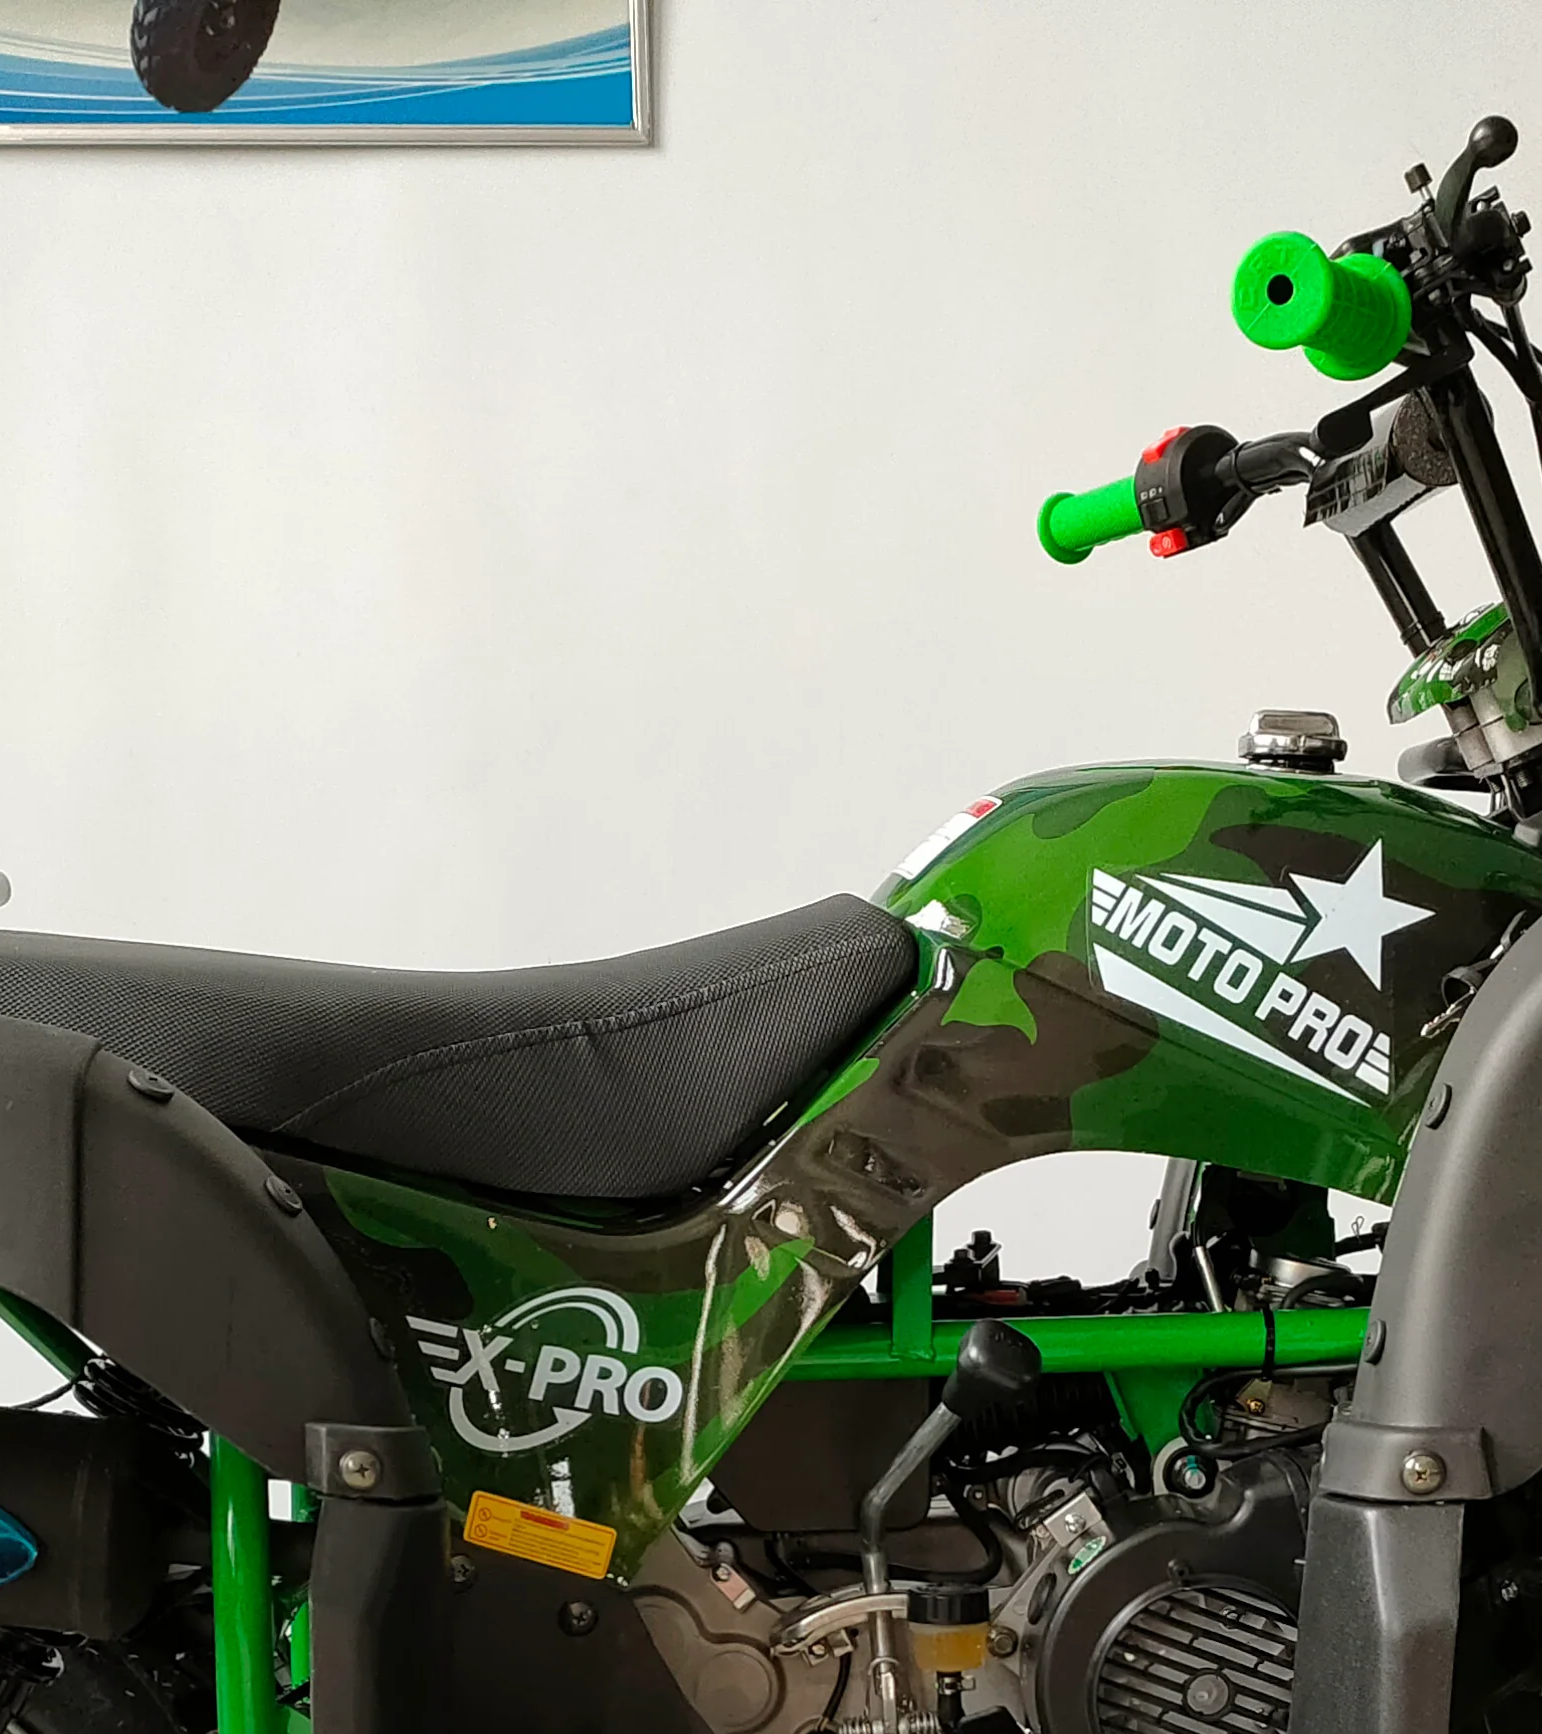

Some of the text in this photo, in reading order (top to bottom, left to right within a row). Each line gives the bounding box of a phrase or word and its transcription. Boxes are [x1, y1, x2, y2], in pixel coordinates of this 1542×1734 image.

[1105, 885, 1372, 1072] MOTO PRO
[453, 1328, 683, 1423] X-PRO
